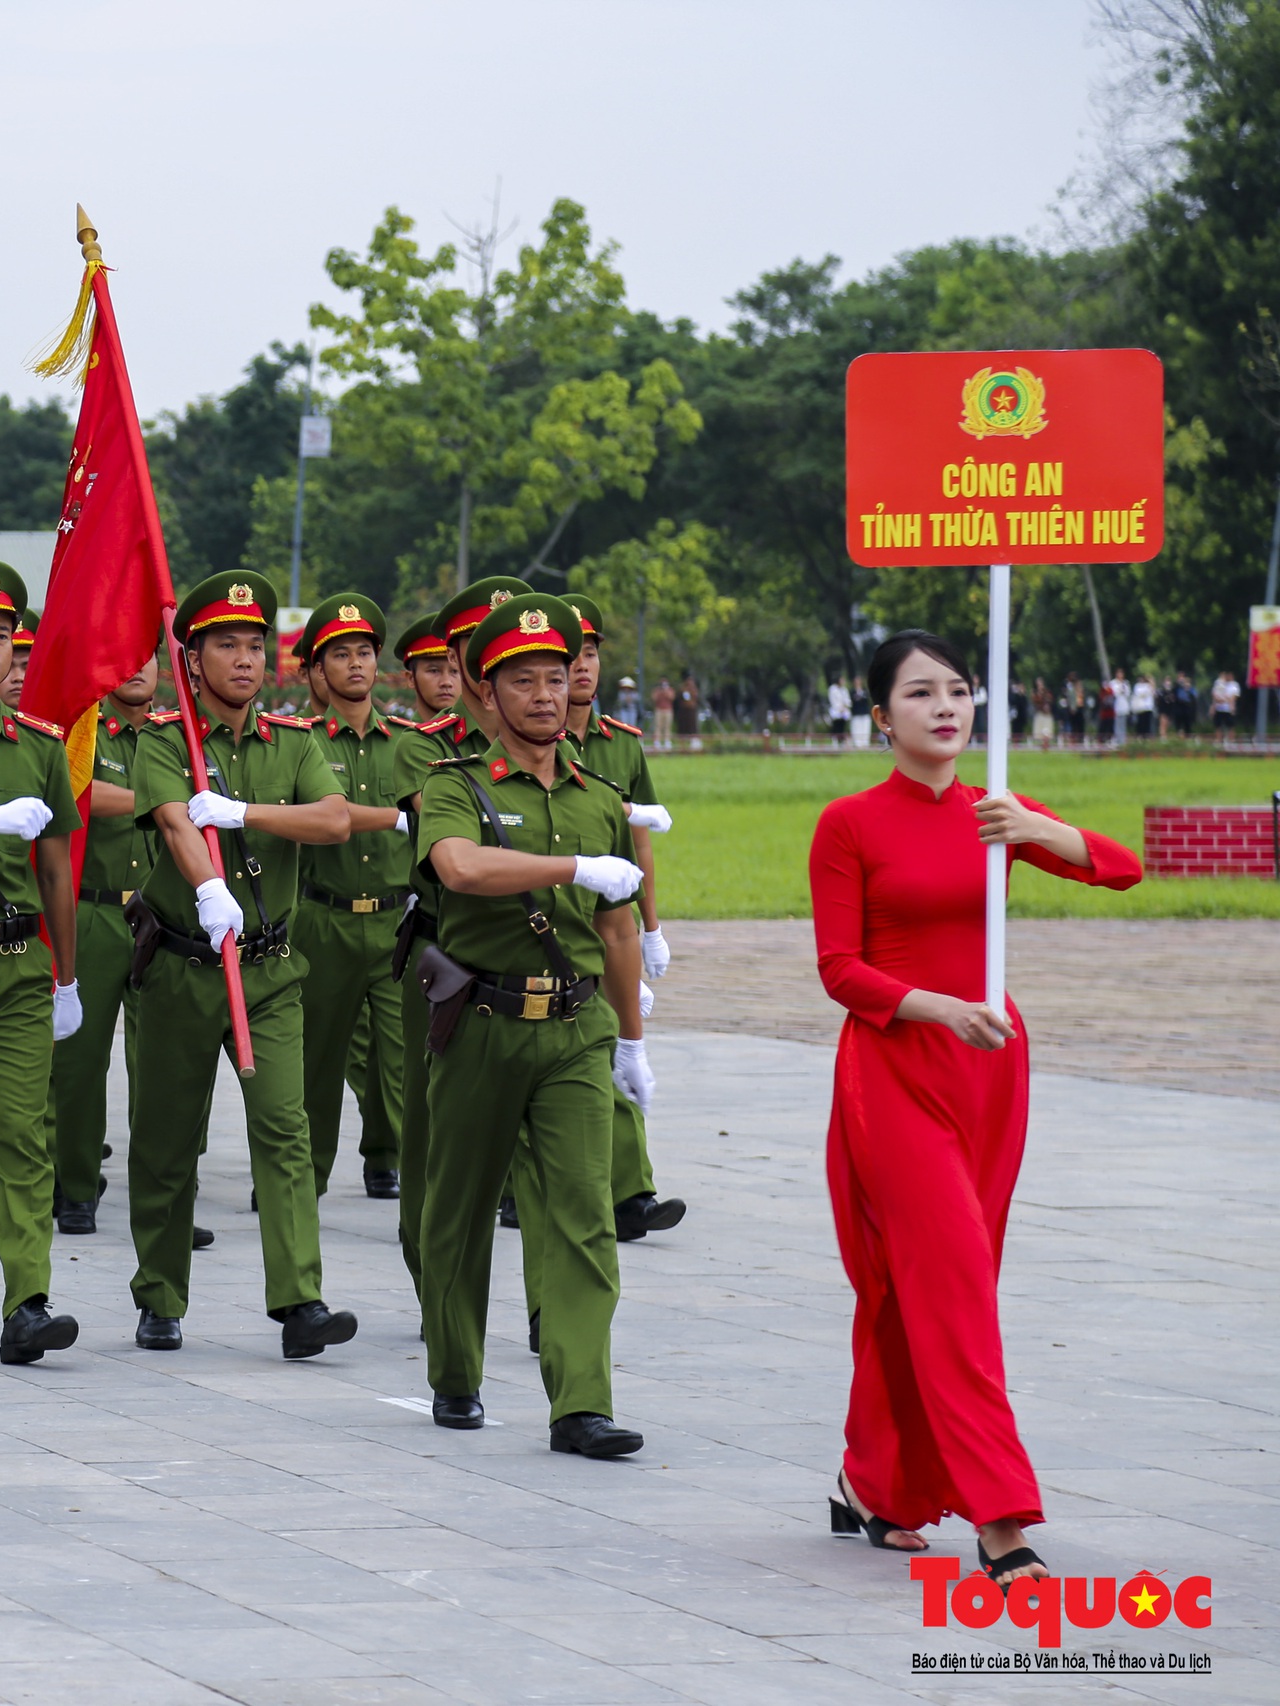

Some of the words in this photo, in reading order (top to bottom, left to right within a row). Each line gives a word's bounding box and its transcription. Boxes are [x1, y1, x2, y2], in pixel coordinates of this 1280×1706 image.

[942, 456, 1017, 498] CÔNG
[1024, 462, 1063, 497] AN
[860, 502, 922, 549] TỈNH
[929, 505, 999, 547] THỪA
[1006, 503, 1085, 546] THIÊN
[1092, 498, 1148, 545] HUẾ
